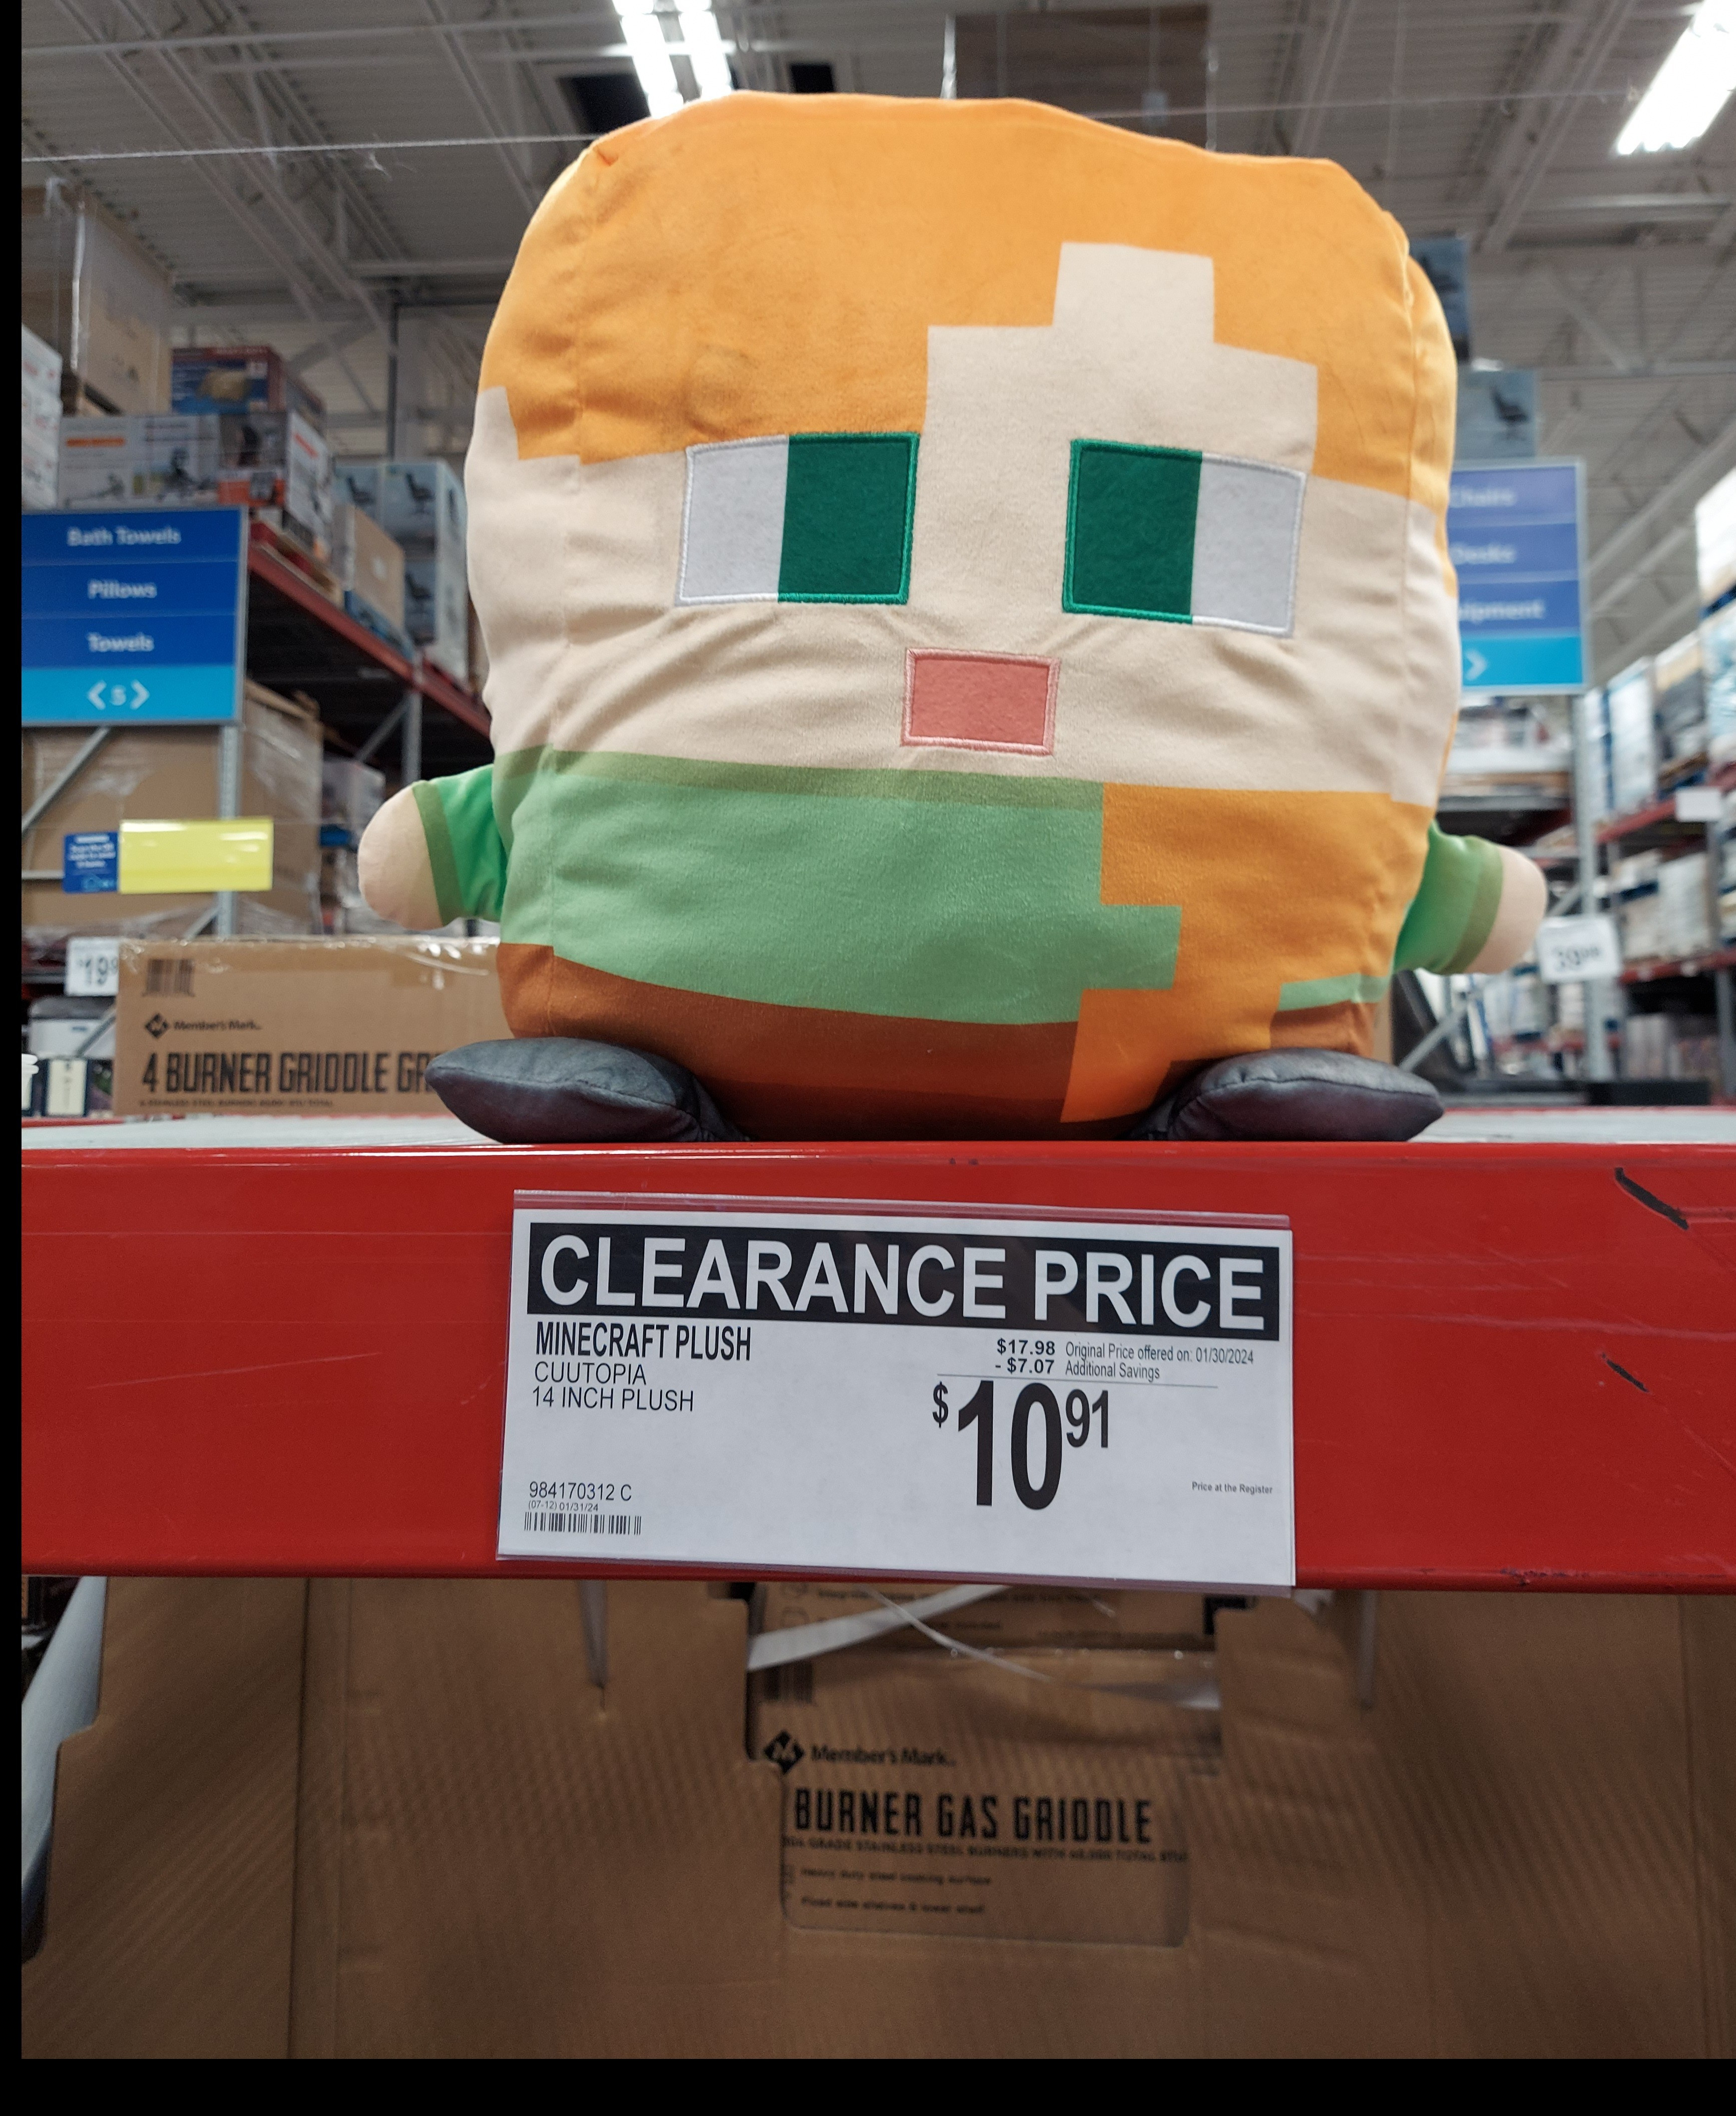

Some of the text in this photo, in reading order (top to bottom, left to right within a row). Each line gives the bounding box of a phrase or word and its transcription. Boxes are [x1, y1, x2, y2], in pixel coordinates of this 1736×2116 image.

[67, 525, 182, 547] Bath Towels
[88, 579, 157, 599] Pillows
[87, 631, 155, 652] Towels
[174, 1020, 226, 1032] Member's
[142, 1052, 158, 1093] 4
[166, 1052, 271, 1093] BURNER
[279, 1052, 389, 1093] GRIDDLE
[541, 1234, 1265, 1330] CLEARANCE PRICE
[536, 1321, 751, 1361] MINECRAFT PLUSH
[997, 1338, 1254, 1365] $17.98 Original Price offered on: 01/30/2024
[535, 1361, 647, 1385] CUUTOPIA
[1007, 1357, 1055, 1376] $7.07
[1065, 1358, 1116, 1377] Additional
[1119, 1362, 1160, 1382] Savings
[533, 1385, 694, 1412] 14 INCH PLUSH
[529, 1481, 632, 1502] 984170312 C
[1191, 1481, 1273, 1496] Price at the Register
[528, 1500, 599, 1512] (07-12) 01/31/24
[810, 1742, 897, 1764] Member's
[795, 1787, 1153, 1844] BURNER GAS GRIDDLE
